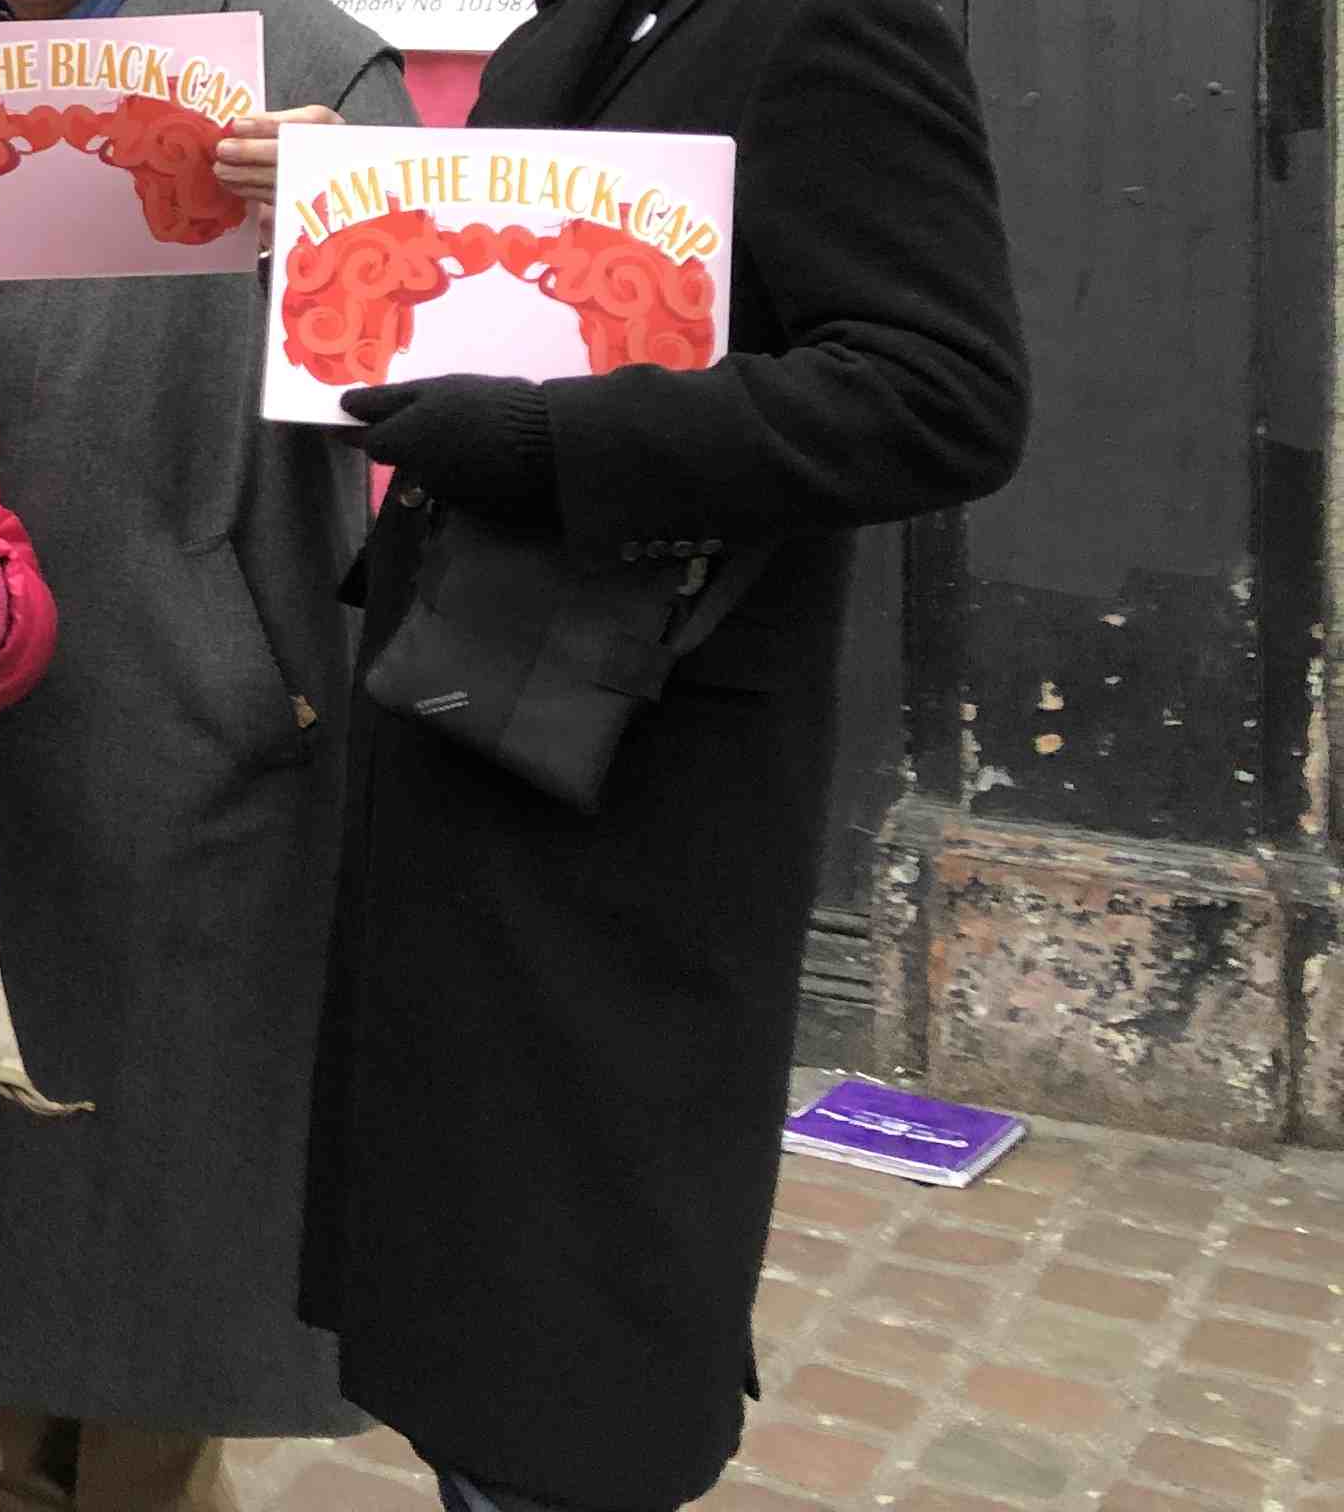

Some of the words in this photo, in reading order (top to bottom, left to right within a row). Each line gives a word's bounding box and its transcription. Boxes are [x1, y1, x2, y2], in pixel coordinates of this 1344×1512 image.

[50, 42, 169, 99] BLACK
[181, 61, 253, 122] CAP
[296, 199, 326, 241] I
[329, 166, 389, 225] AM
[395, 155, 470, 211] THE
[489, 155, 621, 223] BLACK
[632, 188, 719, 260] CAP
